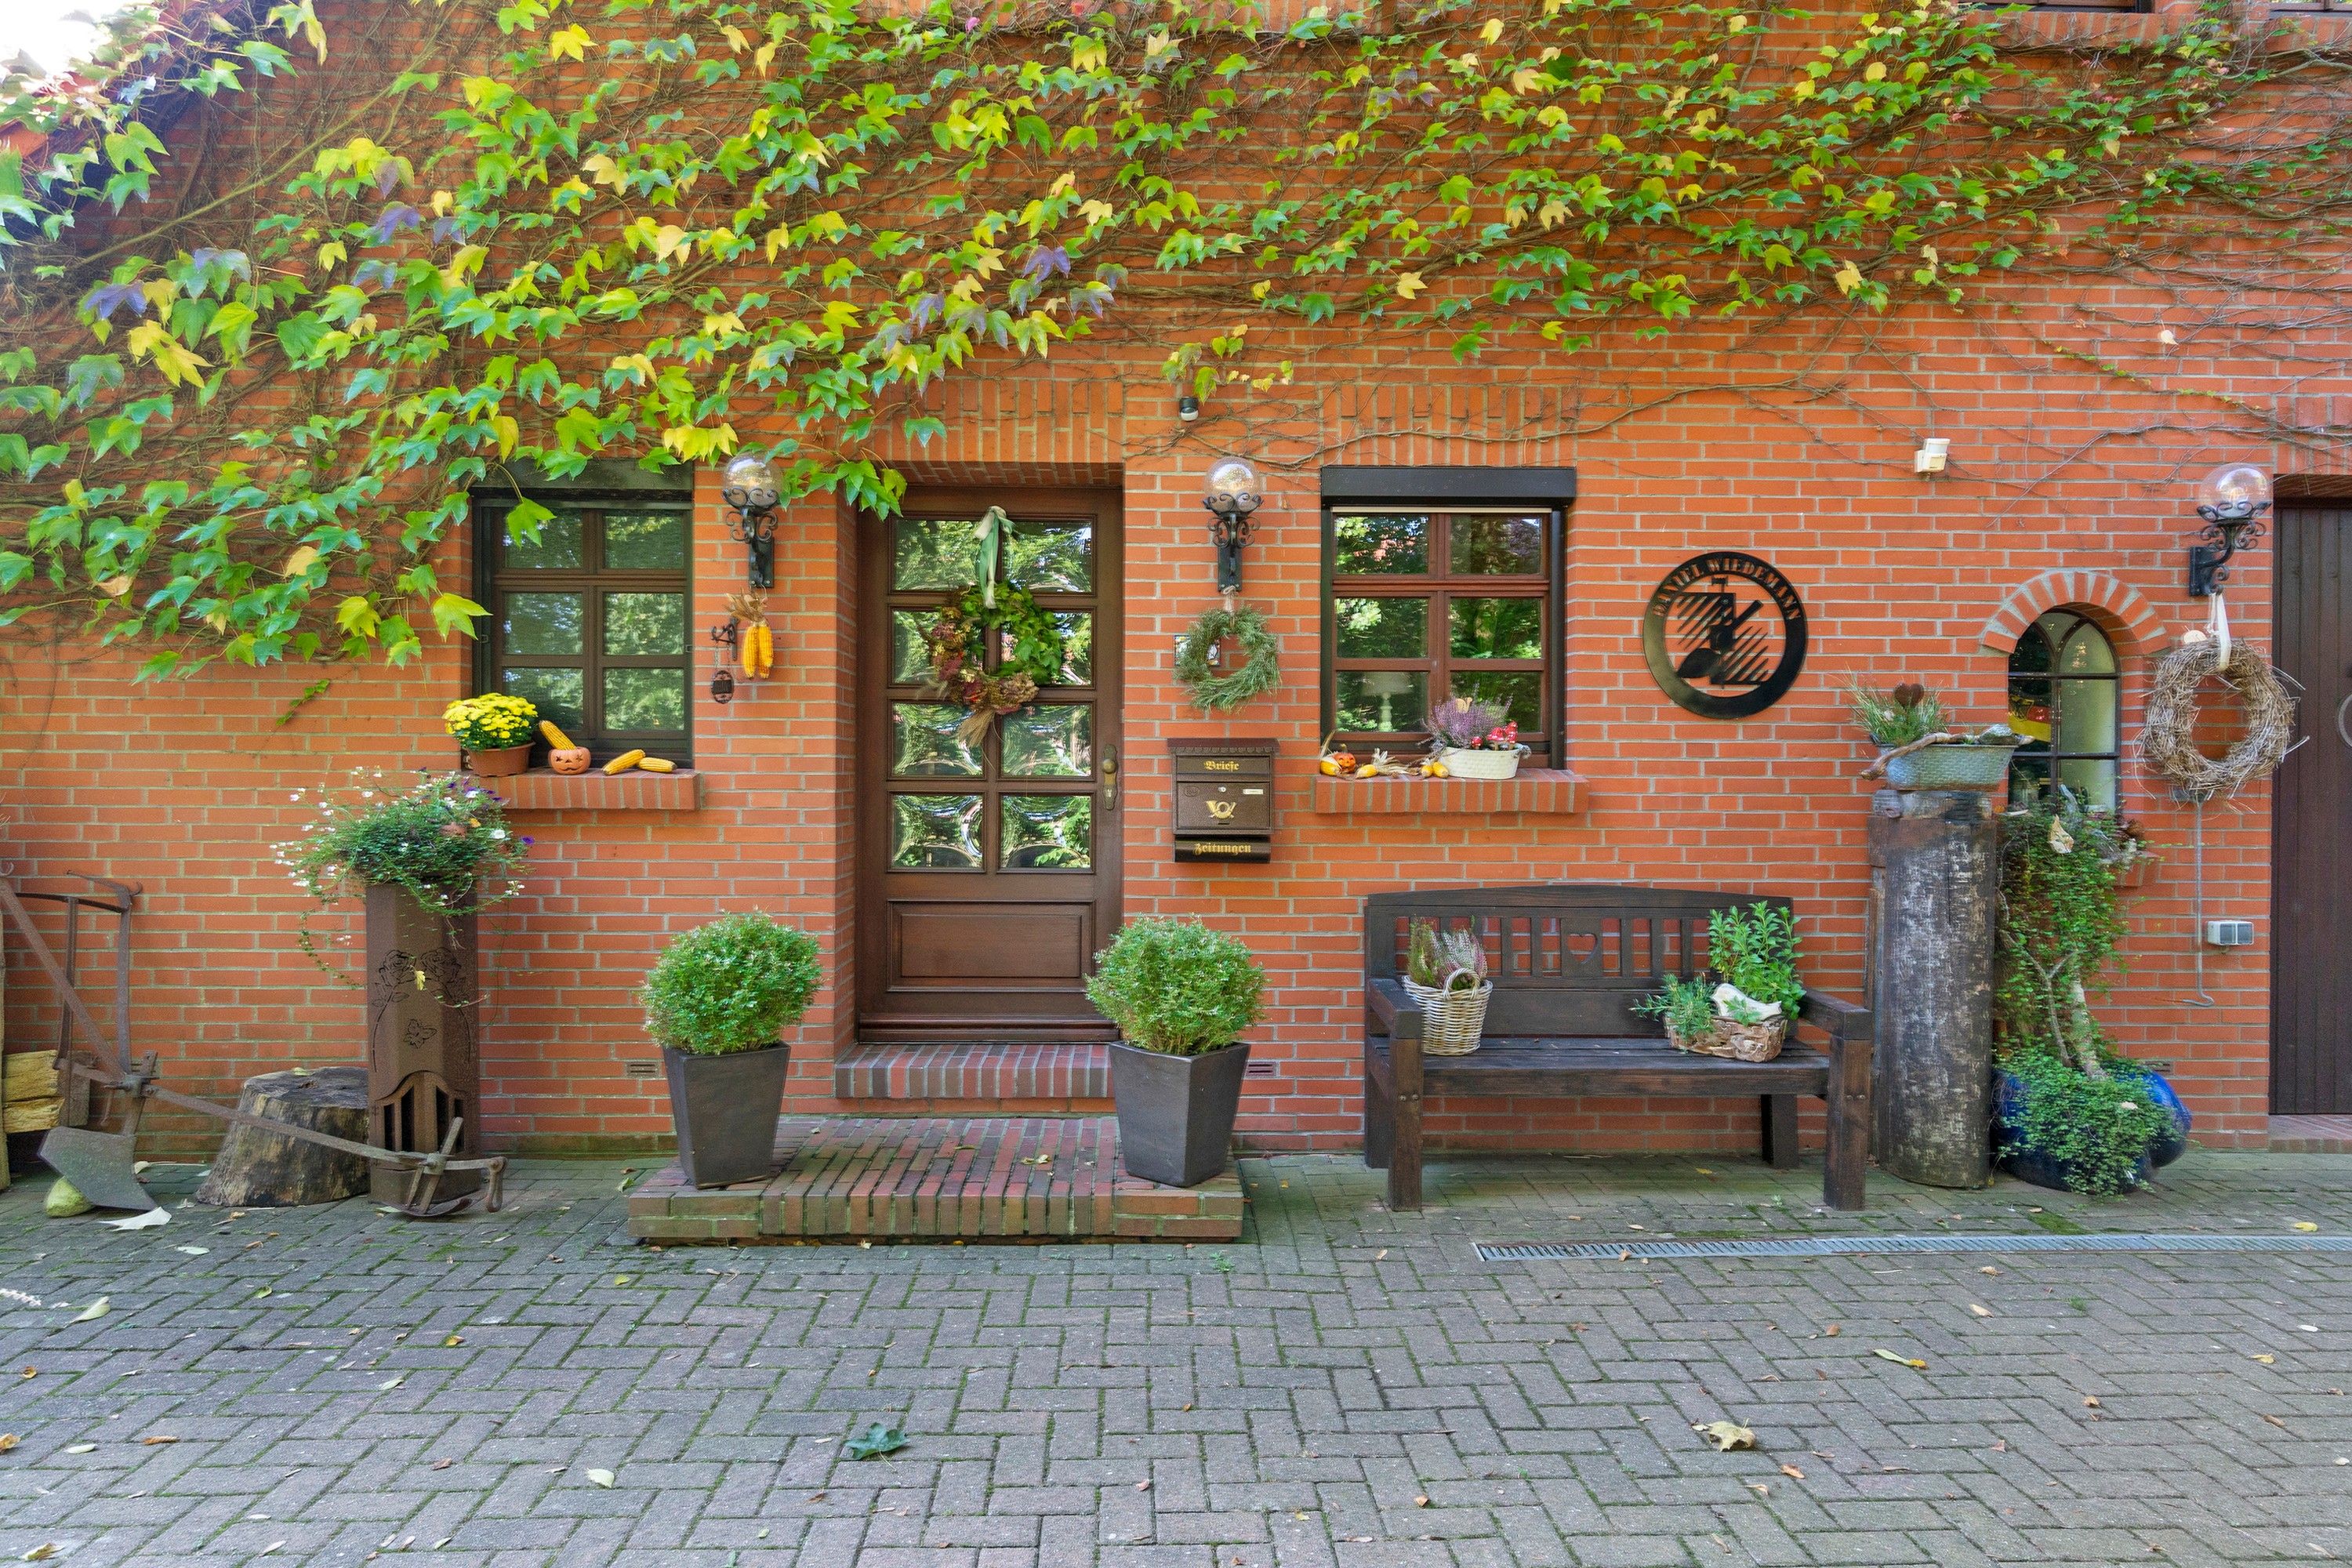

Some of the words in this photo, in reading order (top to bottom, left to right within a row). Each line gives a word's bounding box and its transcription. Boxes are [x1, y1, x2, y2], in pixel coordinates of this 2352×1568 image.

[1652, 563, 1704, 617] DANIEL
[1706, 557, 1802, 620] WIEDEMANN
[1203, 760, 1240, 771] Briefe
[1192, 843, 1252, 855] Zeitungen
